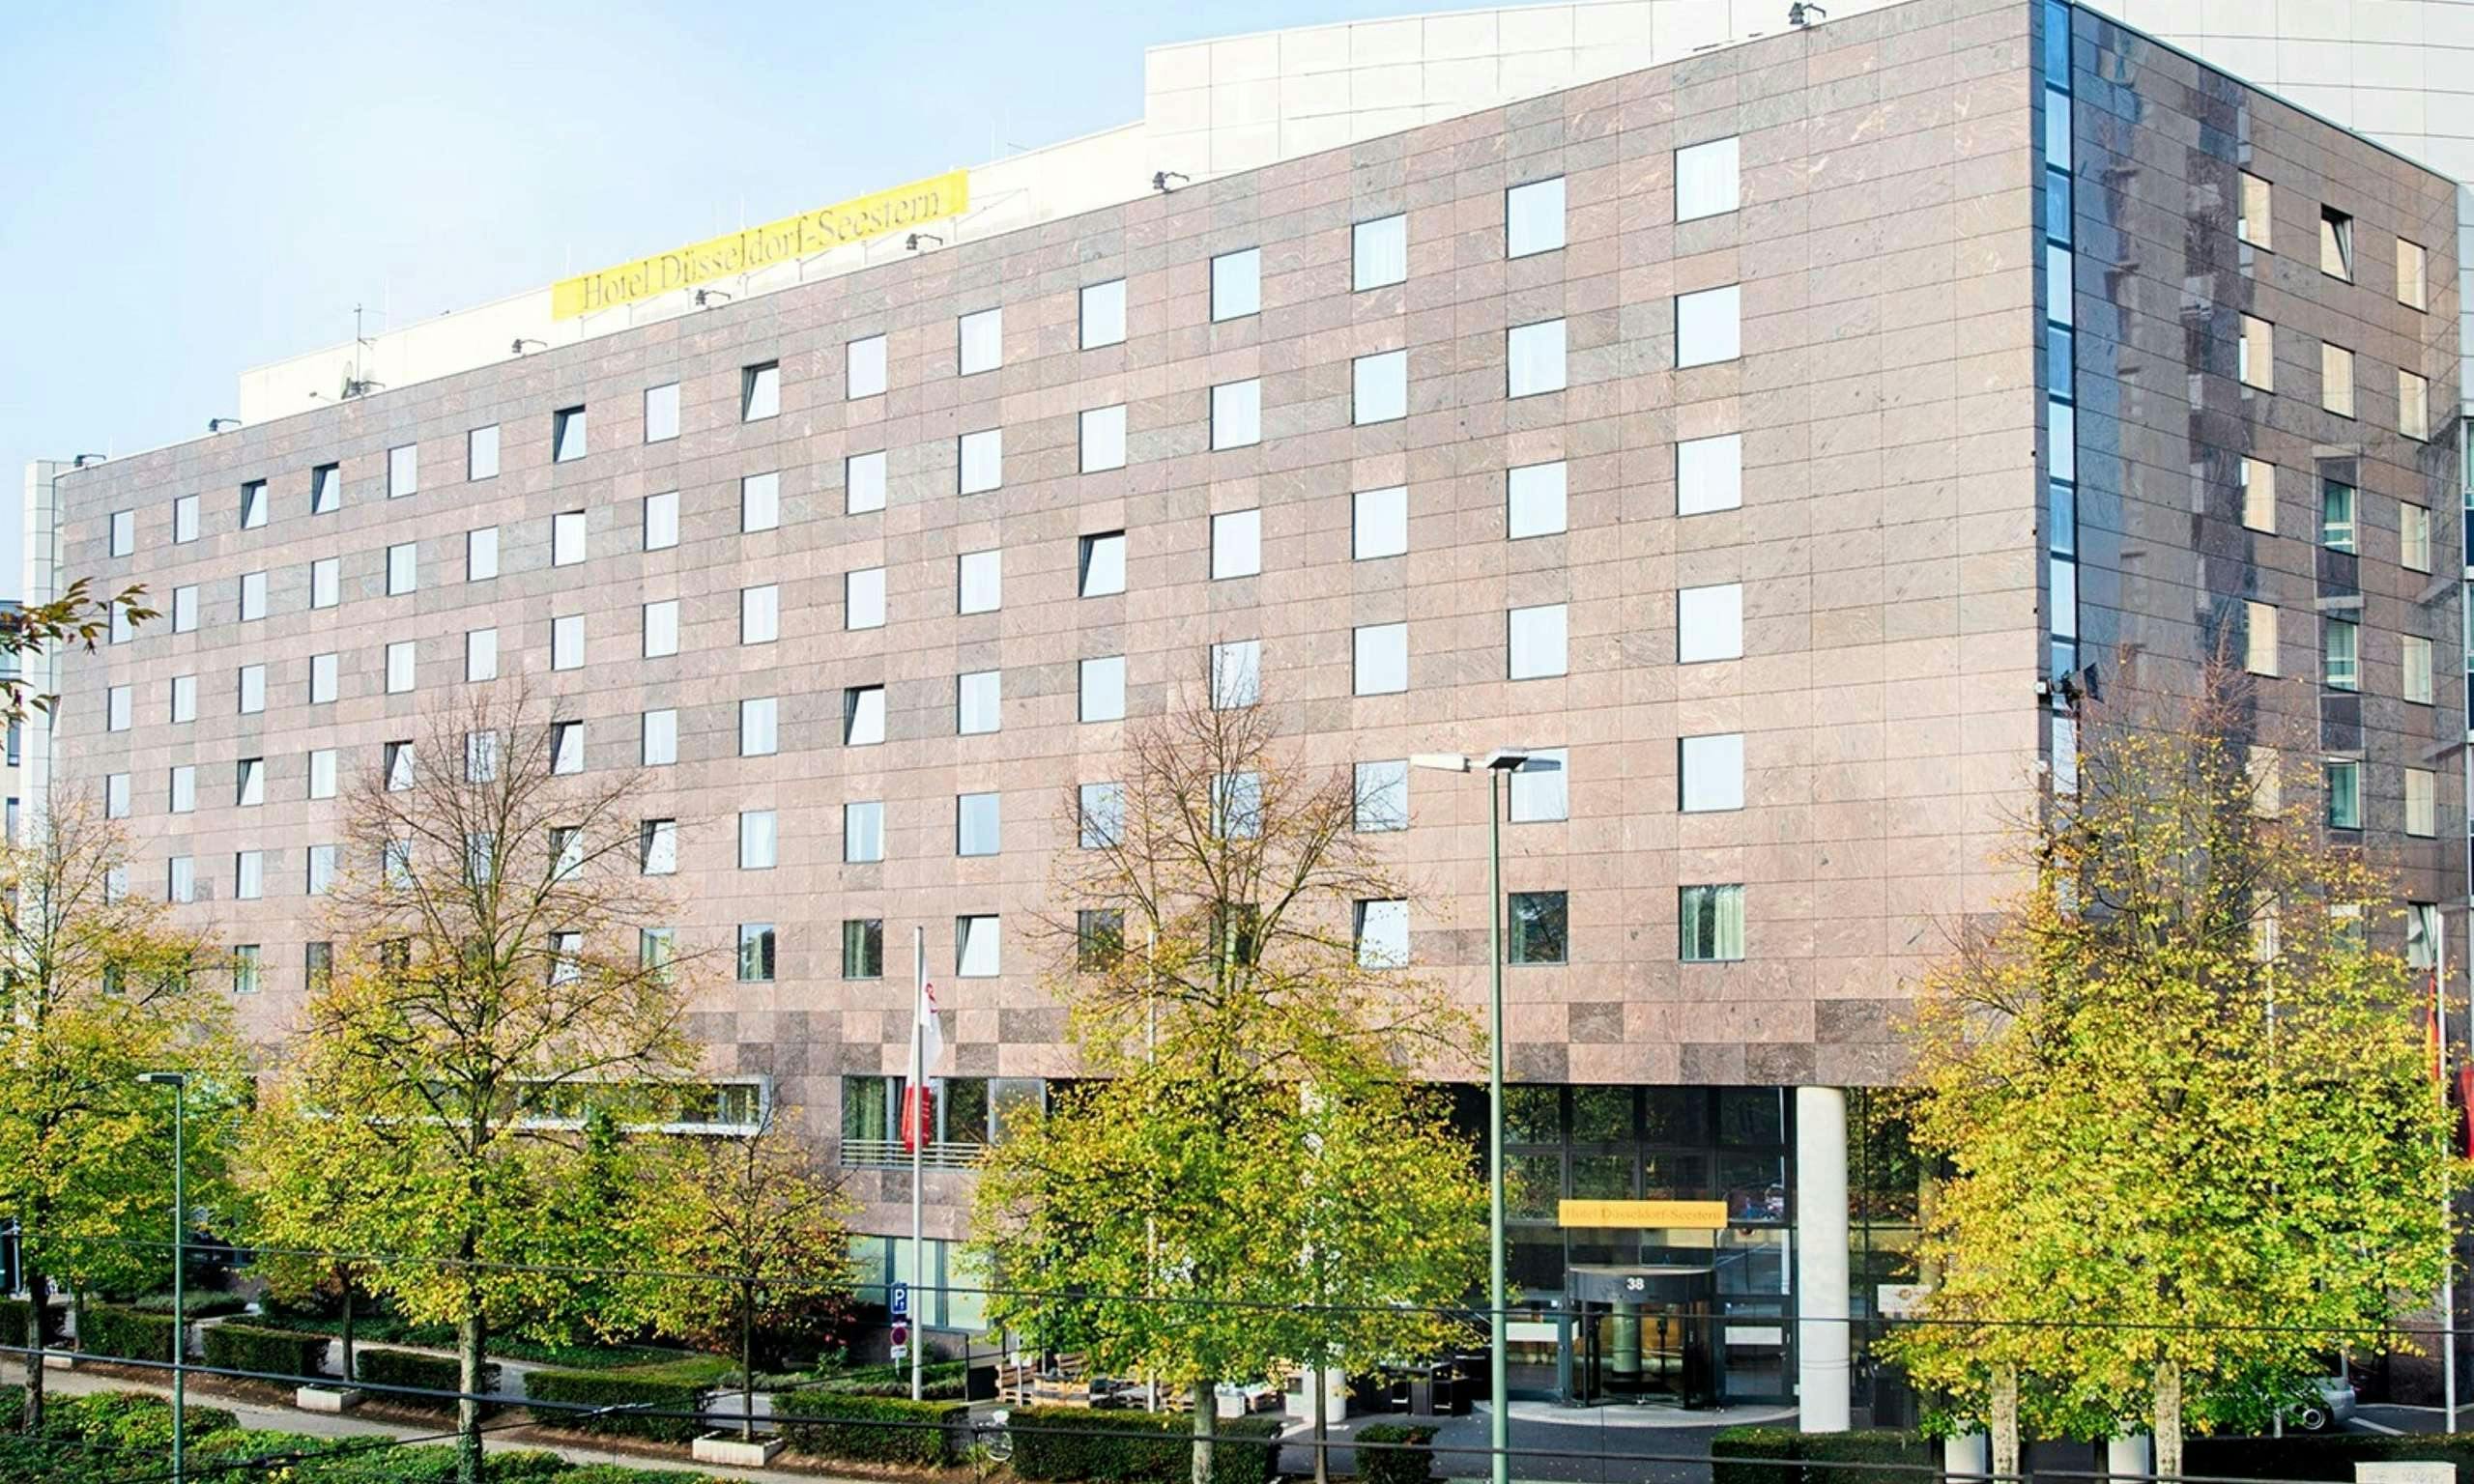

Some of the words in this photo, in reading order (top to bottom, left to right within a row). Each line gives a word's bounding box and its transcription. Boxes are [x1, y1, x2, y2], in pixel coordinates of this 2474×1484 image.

[584, 261, 649, 309] Hotel
[660, 192, 939, 289] Düsseldorf-Seestern
[1565, 1206, 1597, 1220] Hotel
[1626, 1277, 1645, 1290] 38
[895, 1288, 906, 1307] P
